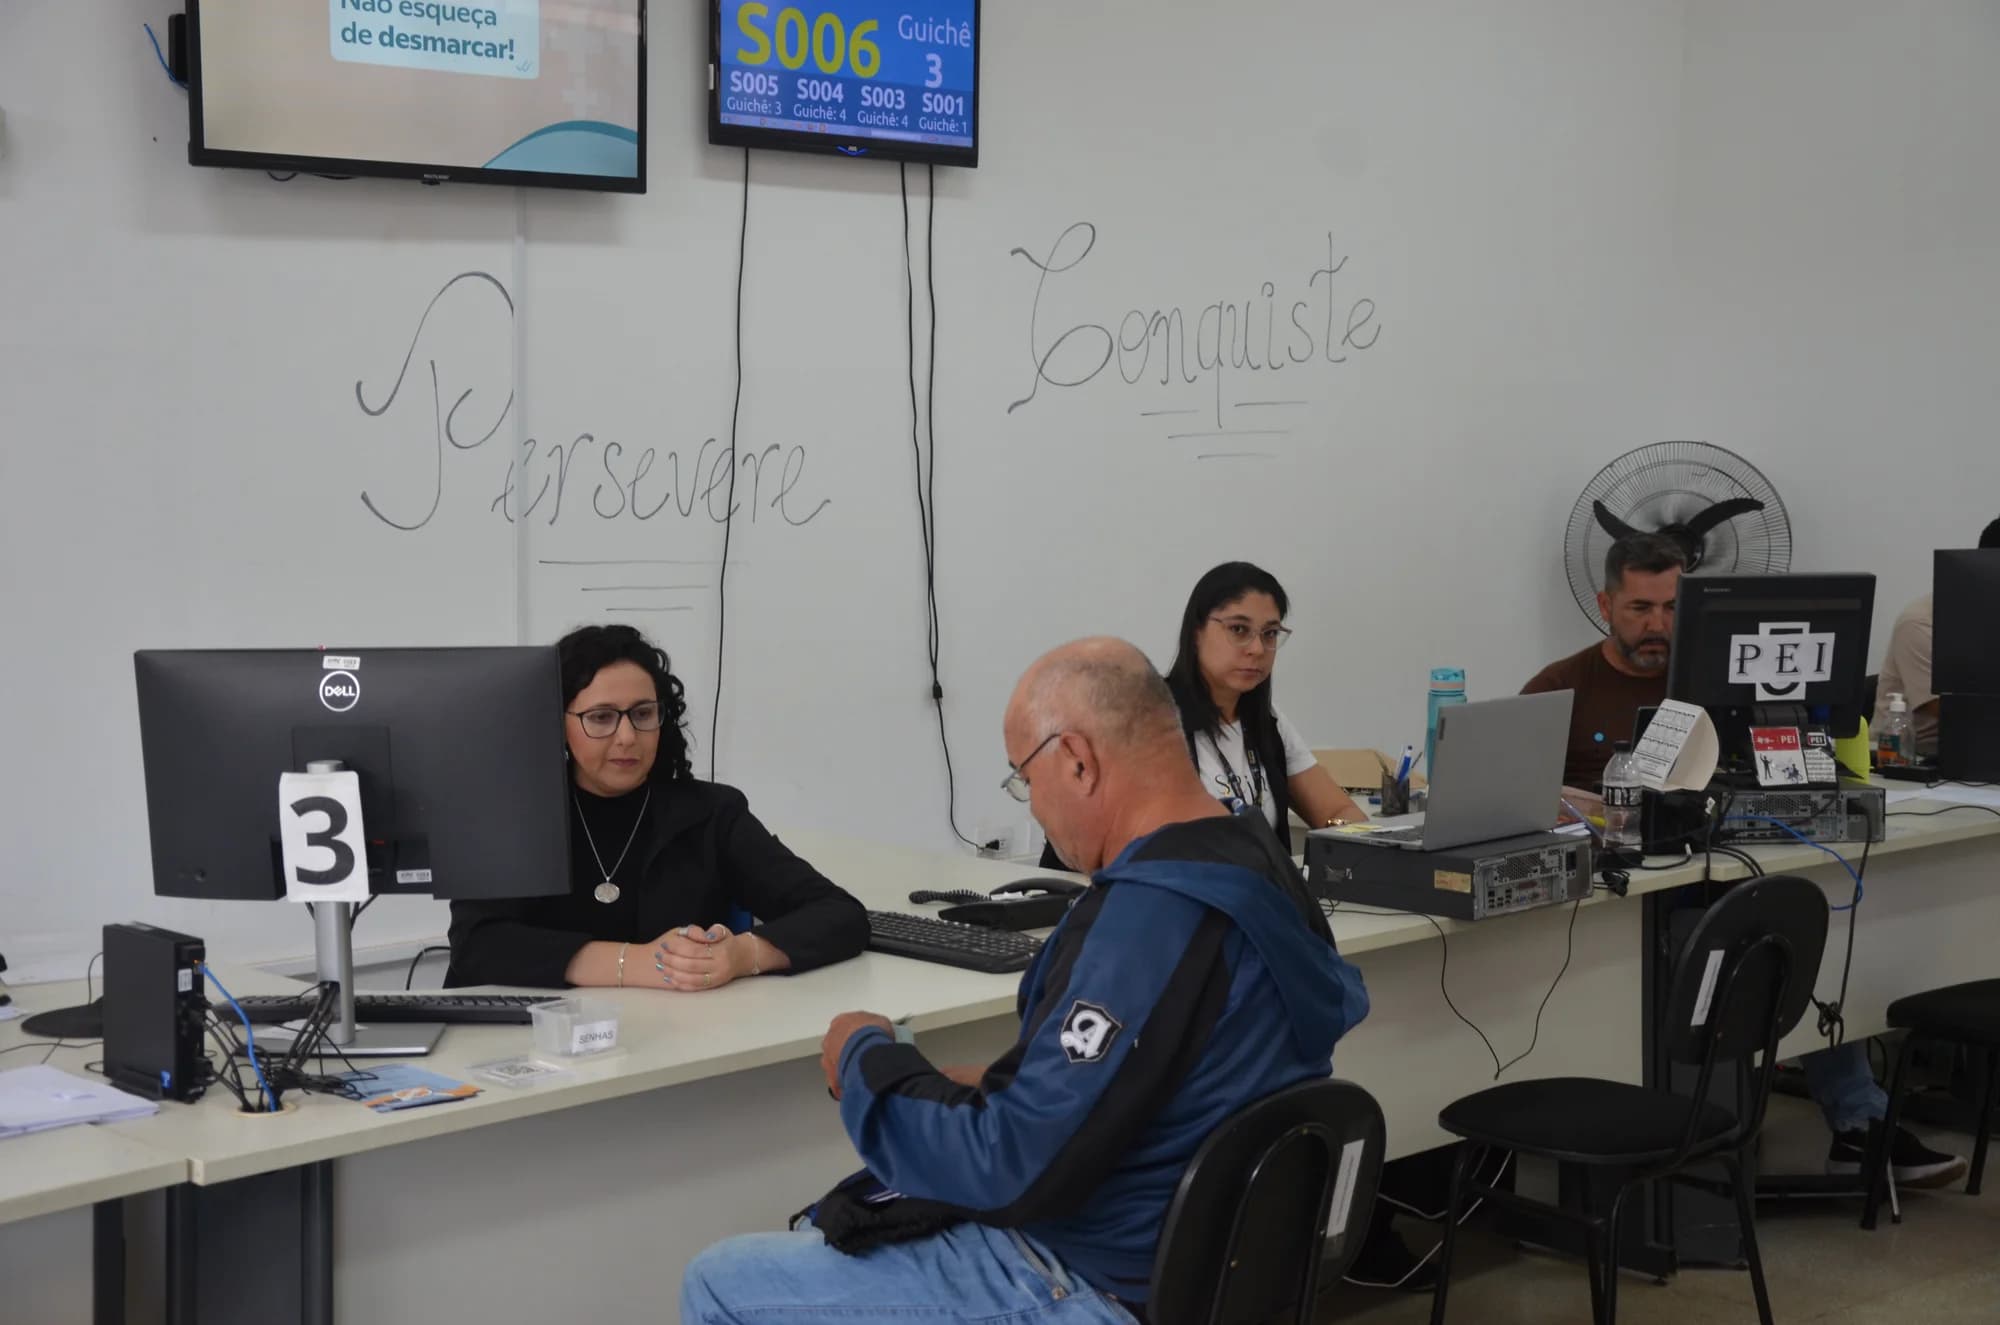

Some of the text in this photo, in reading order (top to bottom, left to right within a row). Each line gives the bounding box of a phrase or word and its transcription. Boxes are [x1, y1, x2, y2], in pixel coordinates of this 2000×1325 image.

[398, 0, 497, 29] esqueça
[341, 21, 514, 60] de desmarcar!
[736, 2, 881, 78] S006
[898, 14, 971, 48] Guichê
[730, 71, 779, 96] S005
[924, 53, 943, 89] 3
[796, 78, 844, 104] S004
[860, 85, 906, 110] S003
[727, 97, 783, 116] Guichê: 3
[793, 104, 847, 122] Guichê: 4
[922, 92, 964, 117] S001
[857, 110, 909, 129] Guichê: 4
[918, 116, 968, 134] Guichê: 1
[1008, 222, 1381, 429] Conquiste
[355, 271, 831, 530] Persevere
[1735, 642, 1826, 676] PEI
[325, 686, 356, 697] DELL
[290, 796, 355, 885] 3
[578, 1030, 614, 1044] SENHAS
